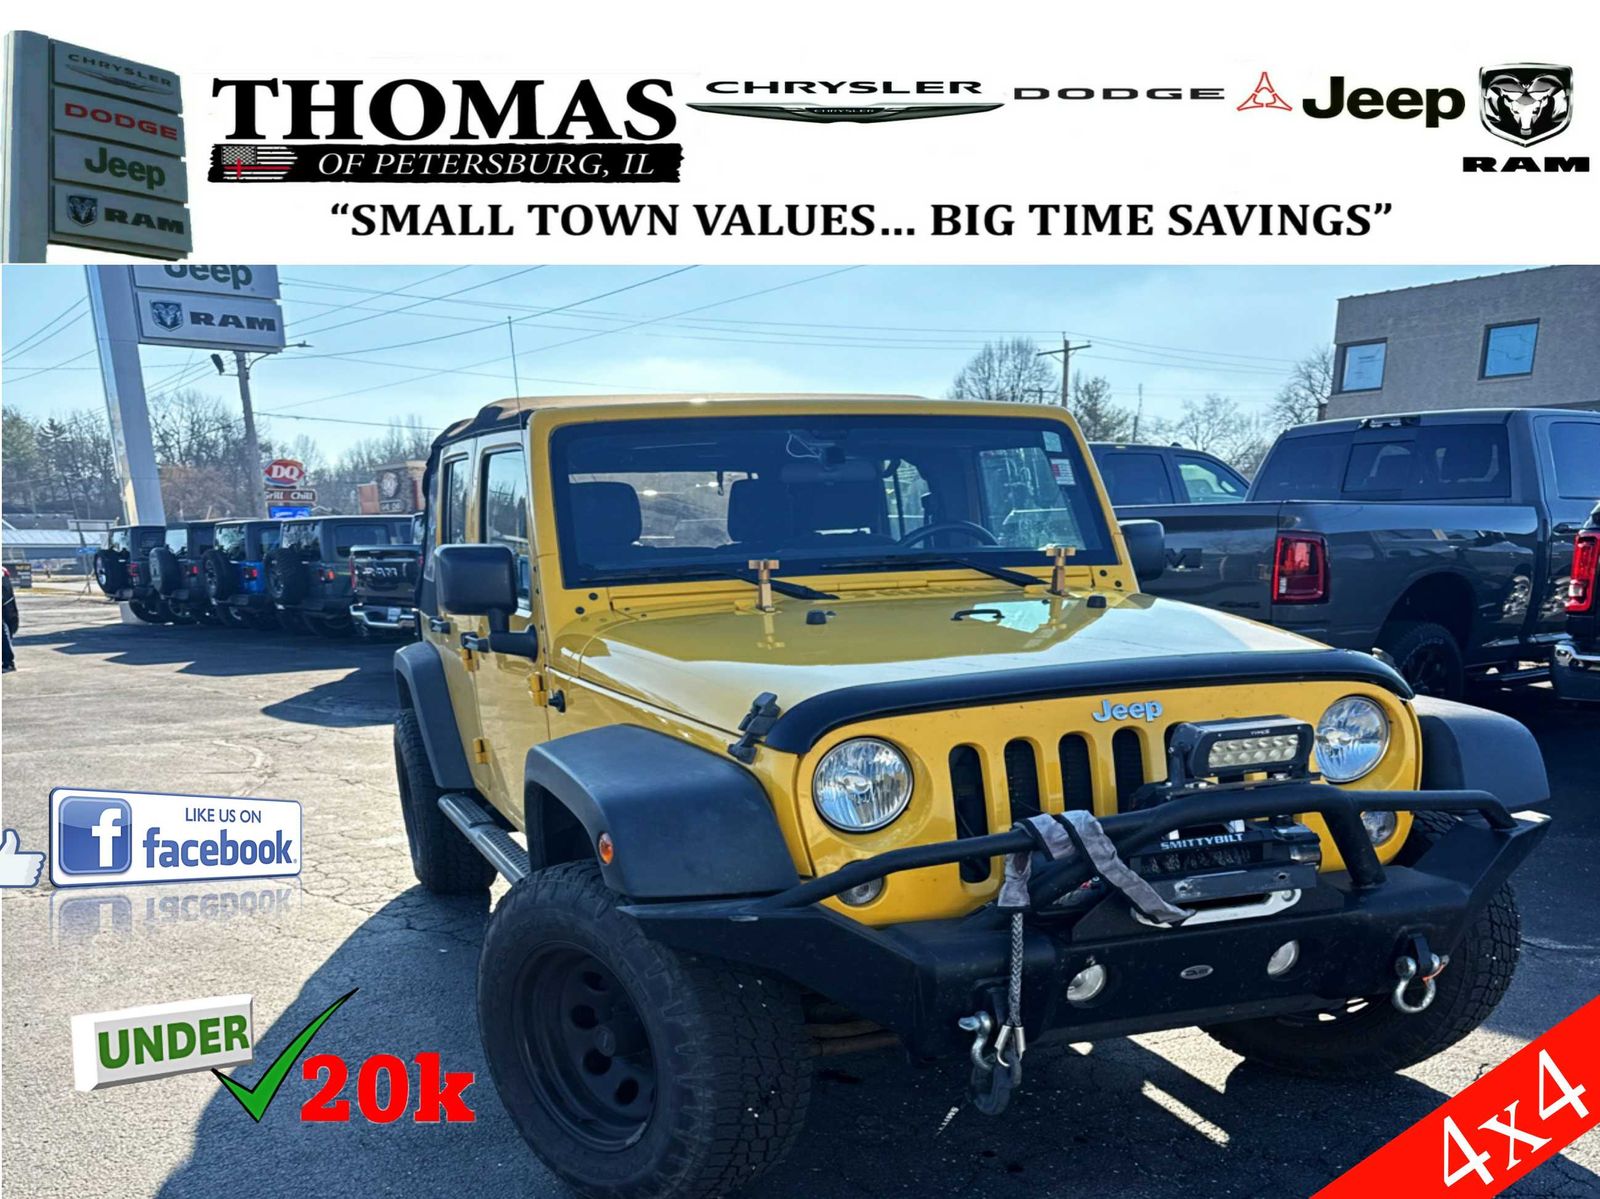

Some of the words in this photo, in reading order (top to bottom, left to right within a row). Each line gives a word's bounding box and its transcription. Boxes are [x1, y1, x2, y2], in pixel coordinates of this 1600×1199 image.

[189, 311, 276, 332] RAM
[271, 465, 299, 480] DQ
[1092, 699, 1164, 723] Jeep
[1160, 833, 1244, 850] SMITTYBILT
